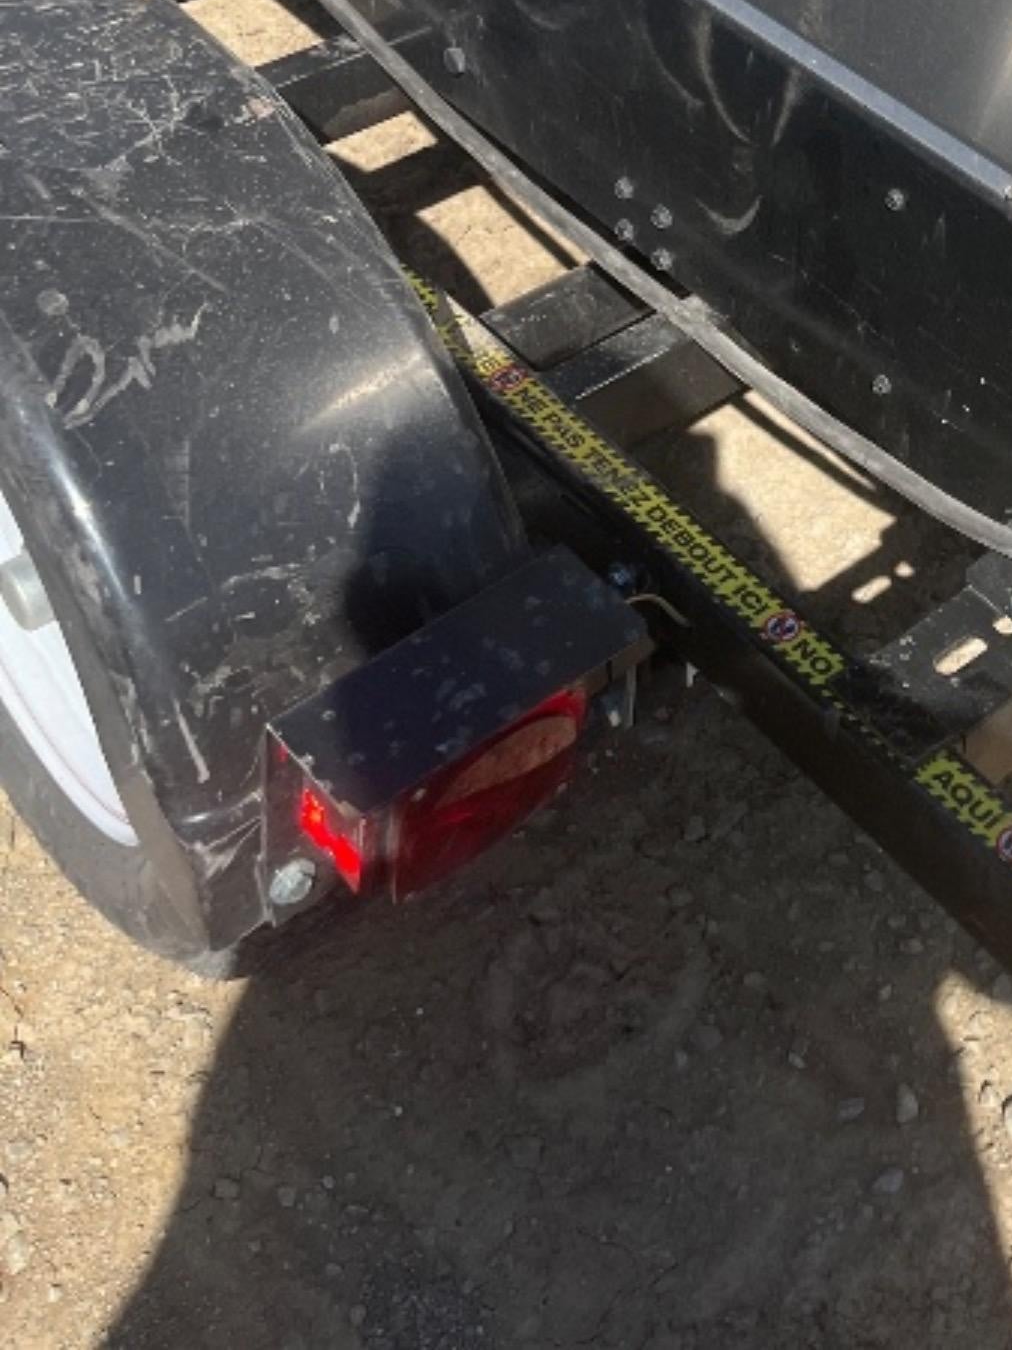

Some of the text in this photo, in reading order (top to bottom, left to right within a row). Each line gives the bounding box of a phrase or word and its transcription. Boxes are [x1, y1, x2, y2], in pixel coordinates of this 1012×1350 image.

[544, 412, 586, 448] PAS
[645, 502, 740, 584] DEBOUT
[732, 585, 768, 616] ICI
[791, 639, 833, 675] NO
[931, 769, 999, 828] AQUI
